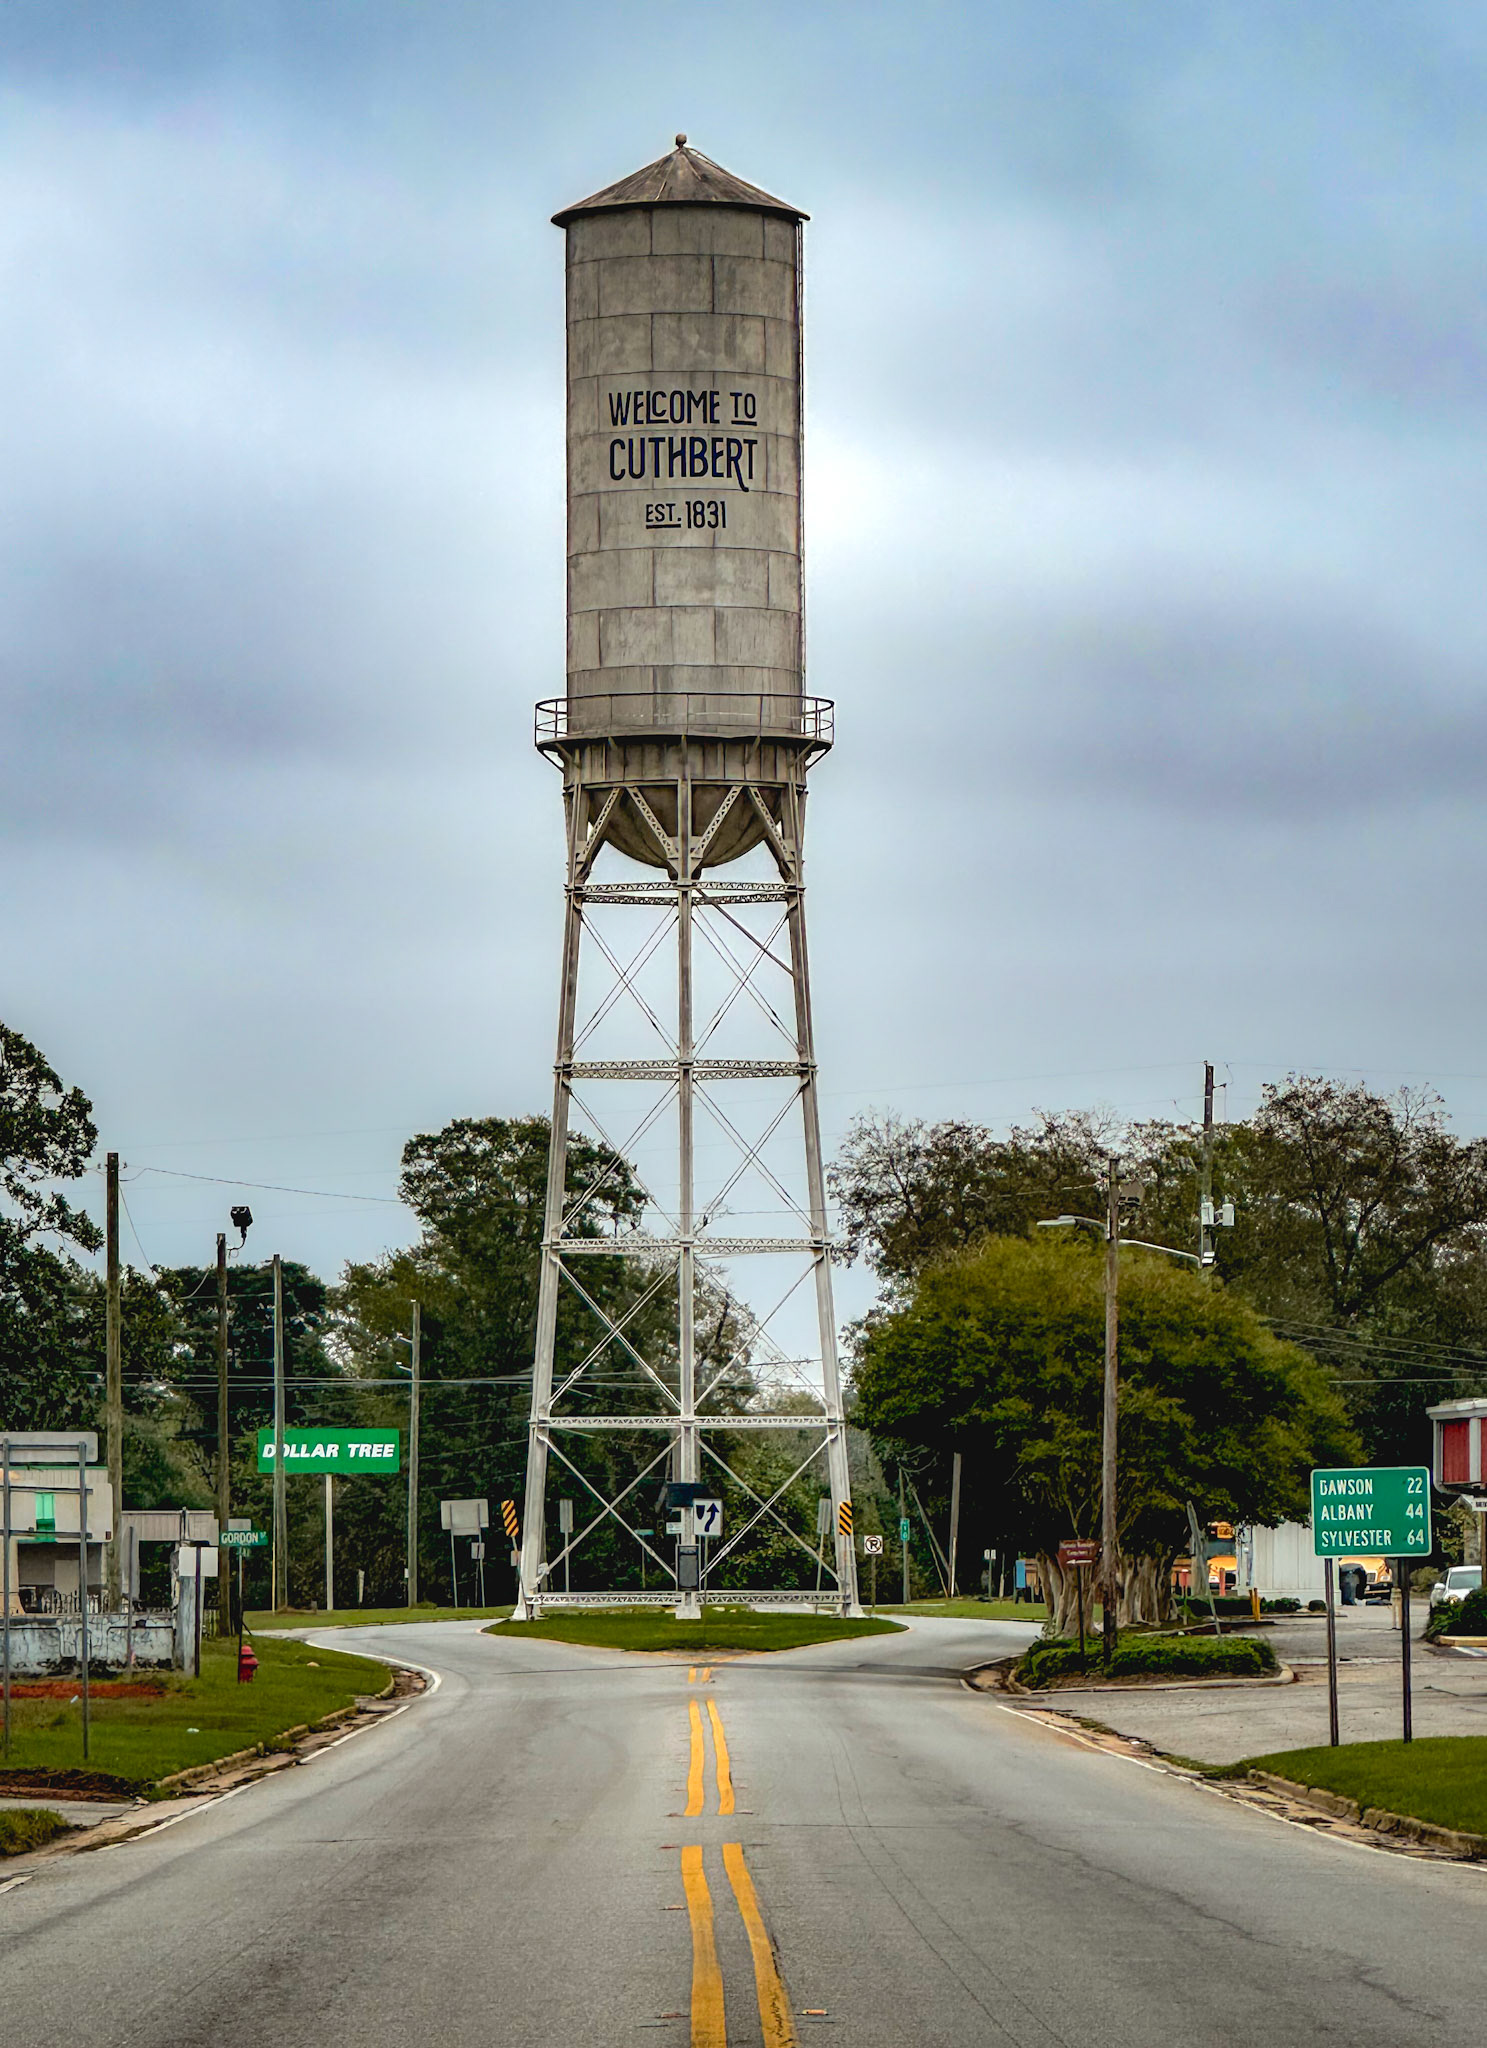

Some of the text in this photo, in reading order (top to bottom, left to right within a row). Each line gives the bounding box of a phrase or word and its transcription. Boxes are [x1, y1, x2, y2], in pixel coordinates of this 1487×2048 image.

[608, 390, 757, 426] WELCOME TO
[609, 436, 758, 492] CUTHBERT
[645, 500, 727, 529] EST. 1831
[262, 1443, 396, 1458] DOLLAR TREE
[1319, 1477, 1423, 1496] DAWSON 22
[1321, 1503, 1424, 1521] ALBANY 44
[221, 1531, 259, 1544] GORDON
[1321, 1529, 1424, 1547] SYLVESTER 64
